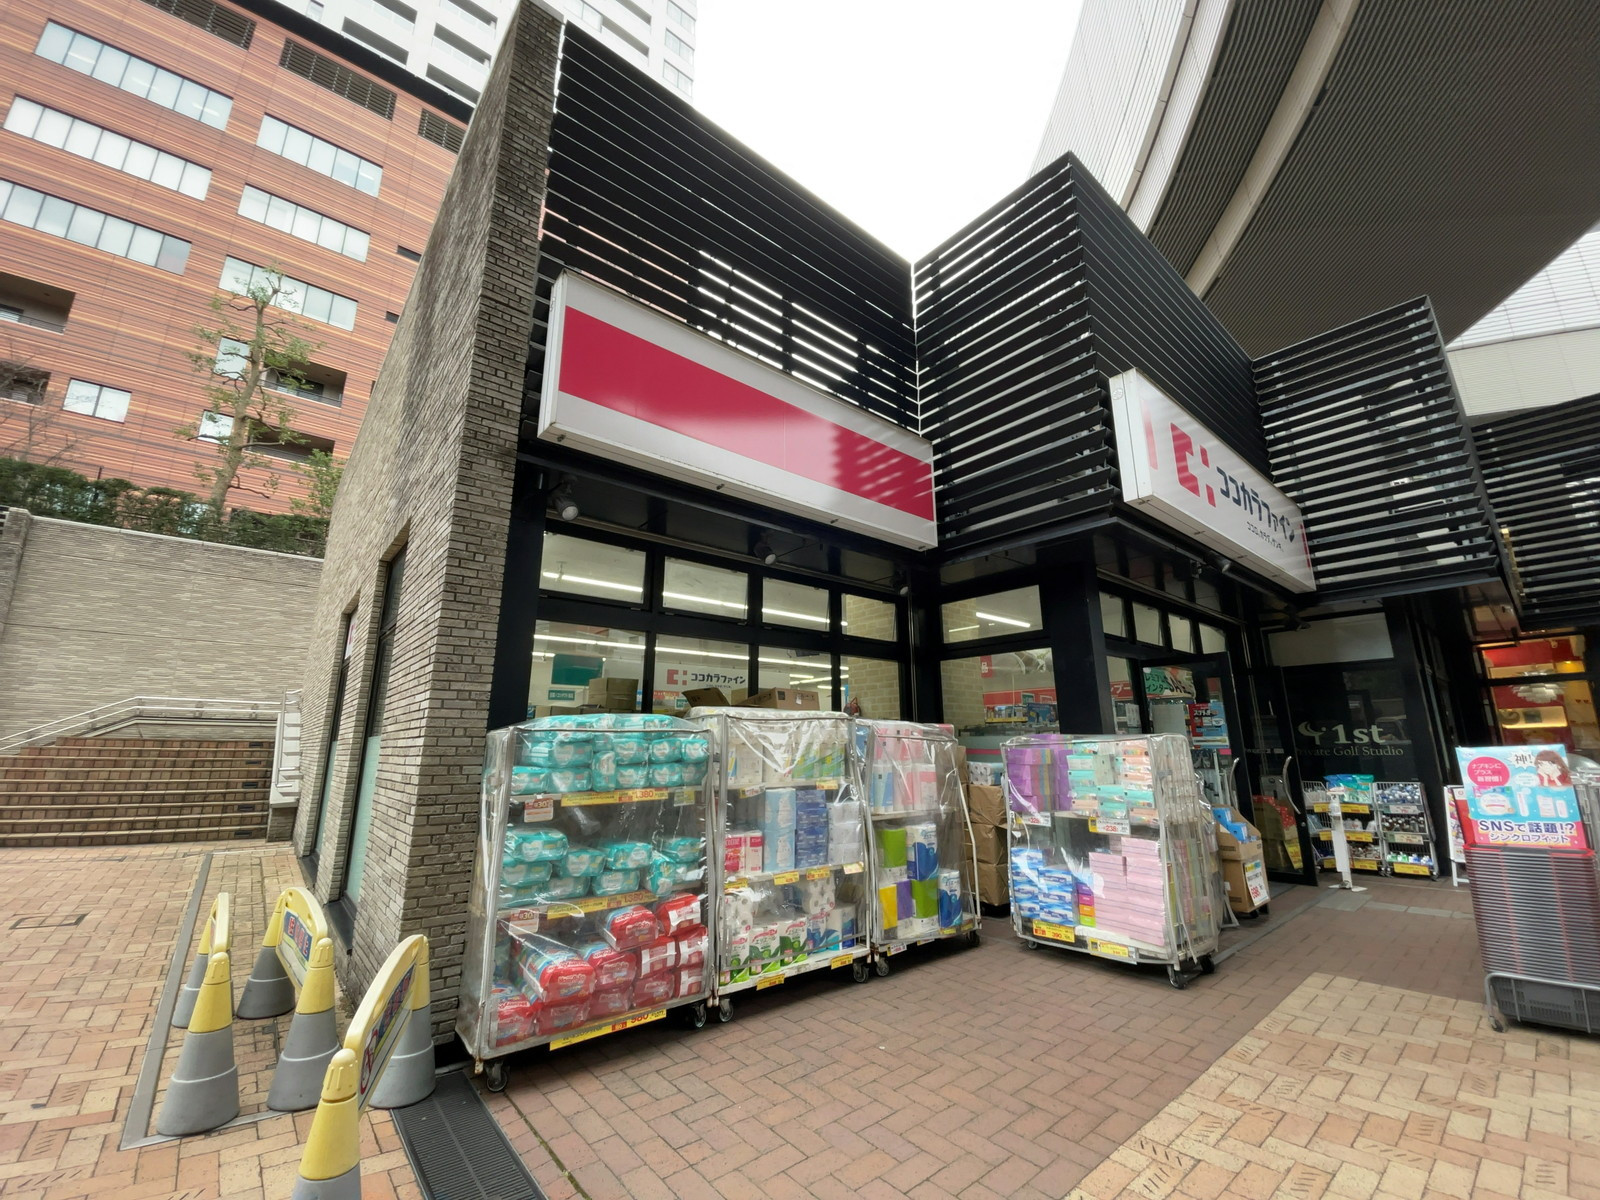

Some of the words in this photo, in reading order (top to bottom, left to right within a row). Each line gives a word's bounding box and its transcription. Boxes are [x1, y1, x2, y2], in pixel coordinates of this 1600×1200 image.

[1216, 466, 1295, 543] ココカラファイン
[691, 672, 746, 685] ココカラファイン
[1331, 723, 1386, 745] 1st
[1297, 747, 1330, 757] rivate
[1333, 745, 1359, 757] Golf
[1362, 745, 1404, 756] Studio
[1479, 819, 1575, 835] SNSで話題!?
[1490, 833, 1569, 844] シンクロフィット
